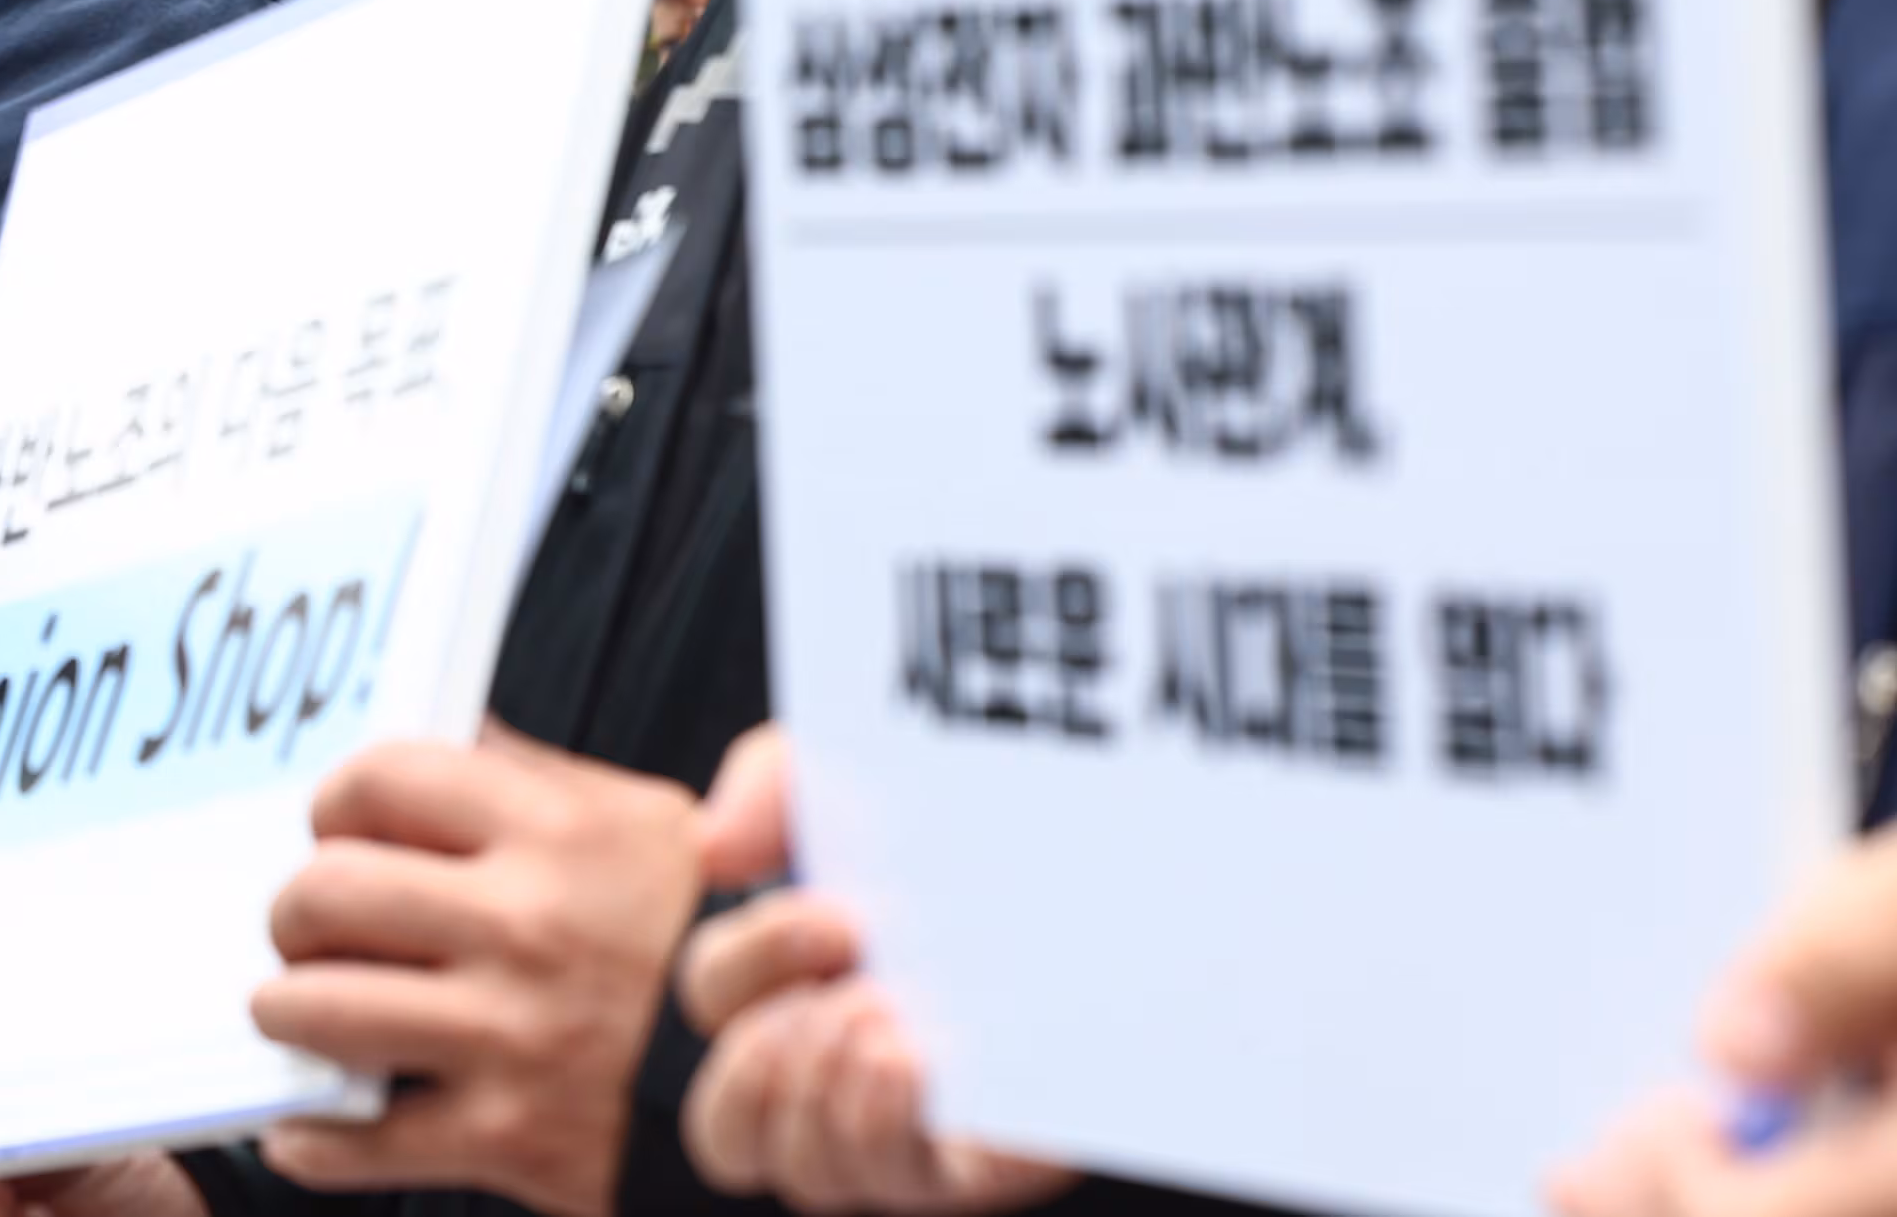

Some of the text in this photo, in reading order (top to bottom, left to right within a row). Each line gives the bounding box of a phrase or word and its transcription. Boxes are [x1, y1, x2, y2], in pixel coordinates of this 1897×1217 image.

[791, 3, 1075, 174] 삼성전자
[219, 319, 324, 475] 다음
[343, 273, 459, 413] 목표
[136, 507, 425, 767] Shop!
[897, 561, 1615, 781] 새로운 시대를 열다
